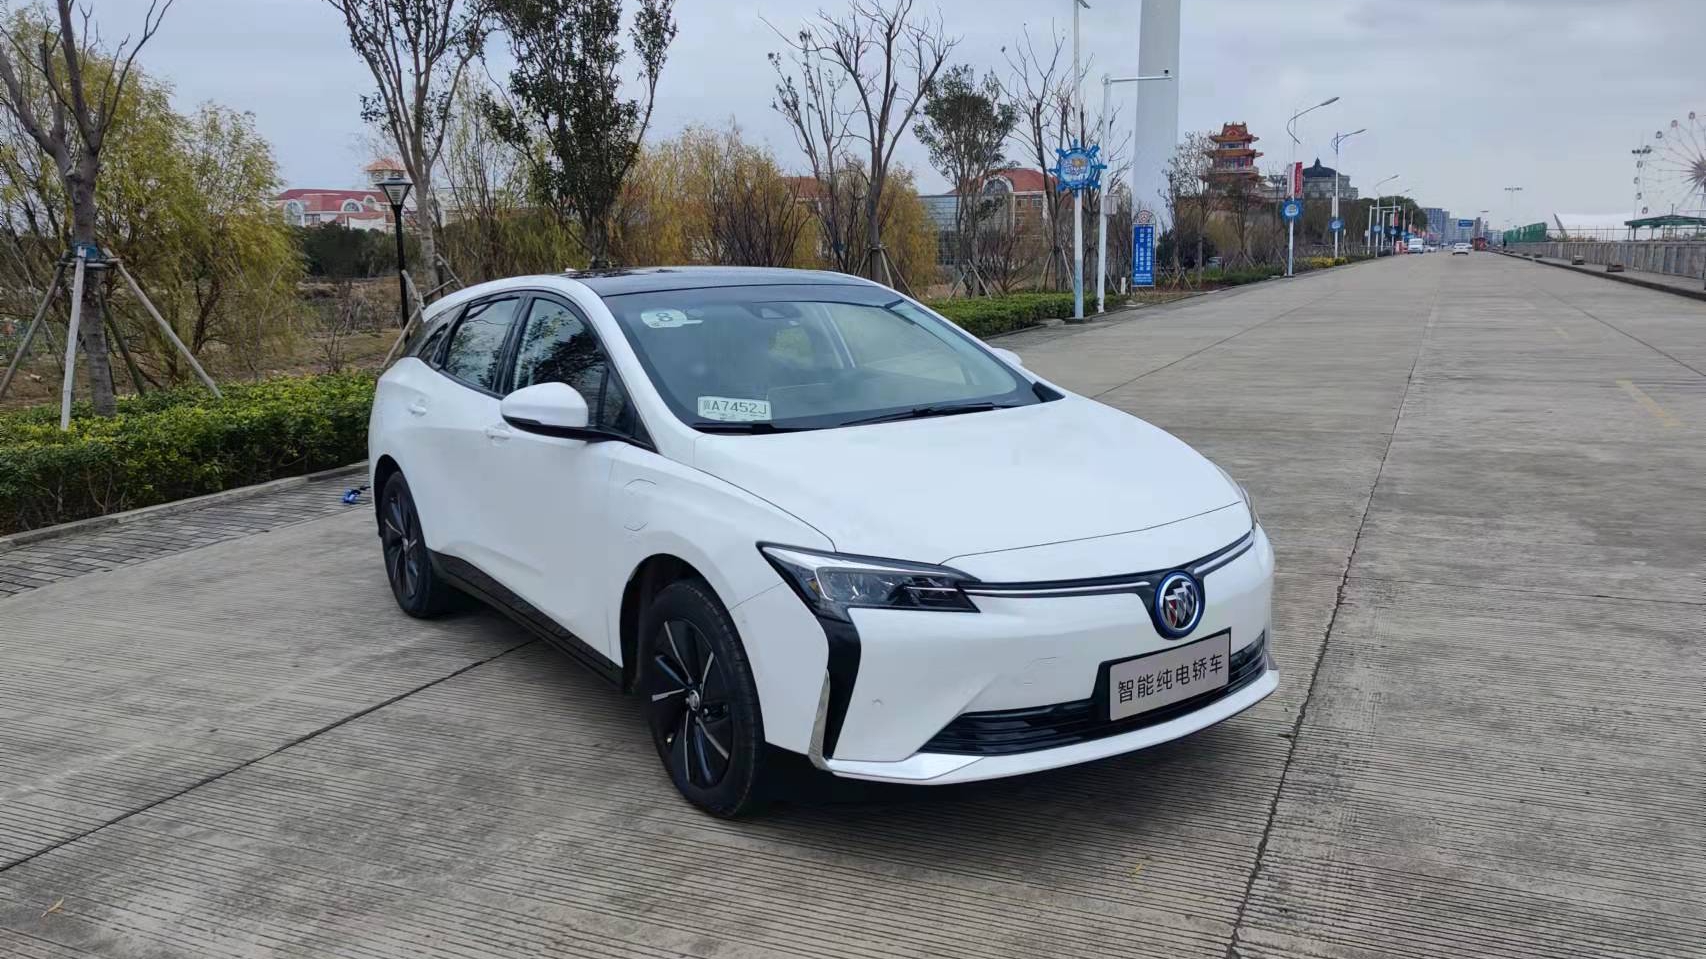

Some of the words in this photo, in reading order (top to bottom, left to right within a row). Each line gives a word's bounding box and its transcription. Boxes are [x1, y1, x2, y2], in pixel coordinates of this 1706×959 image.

[656, 312, 673, 322] 8
[1118, 654, 1223, 704] 智能纯电轿车
